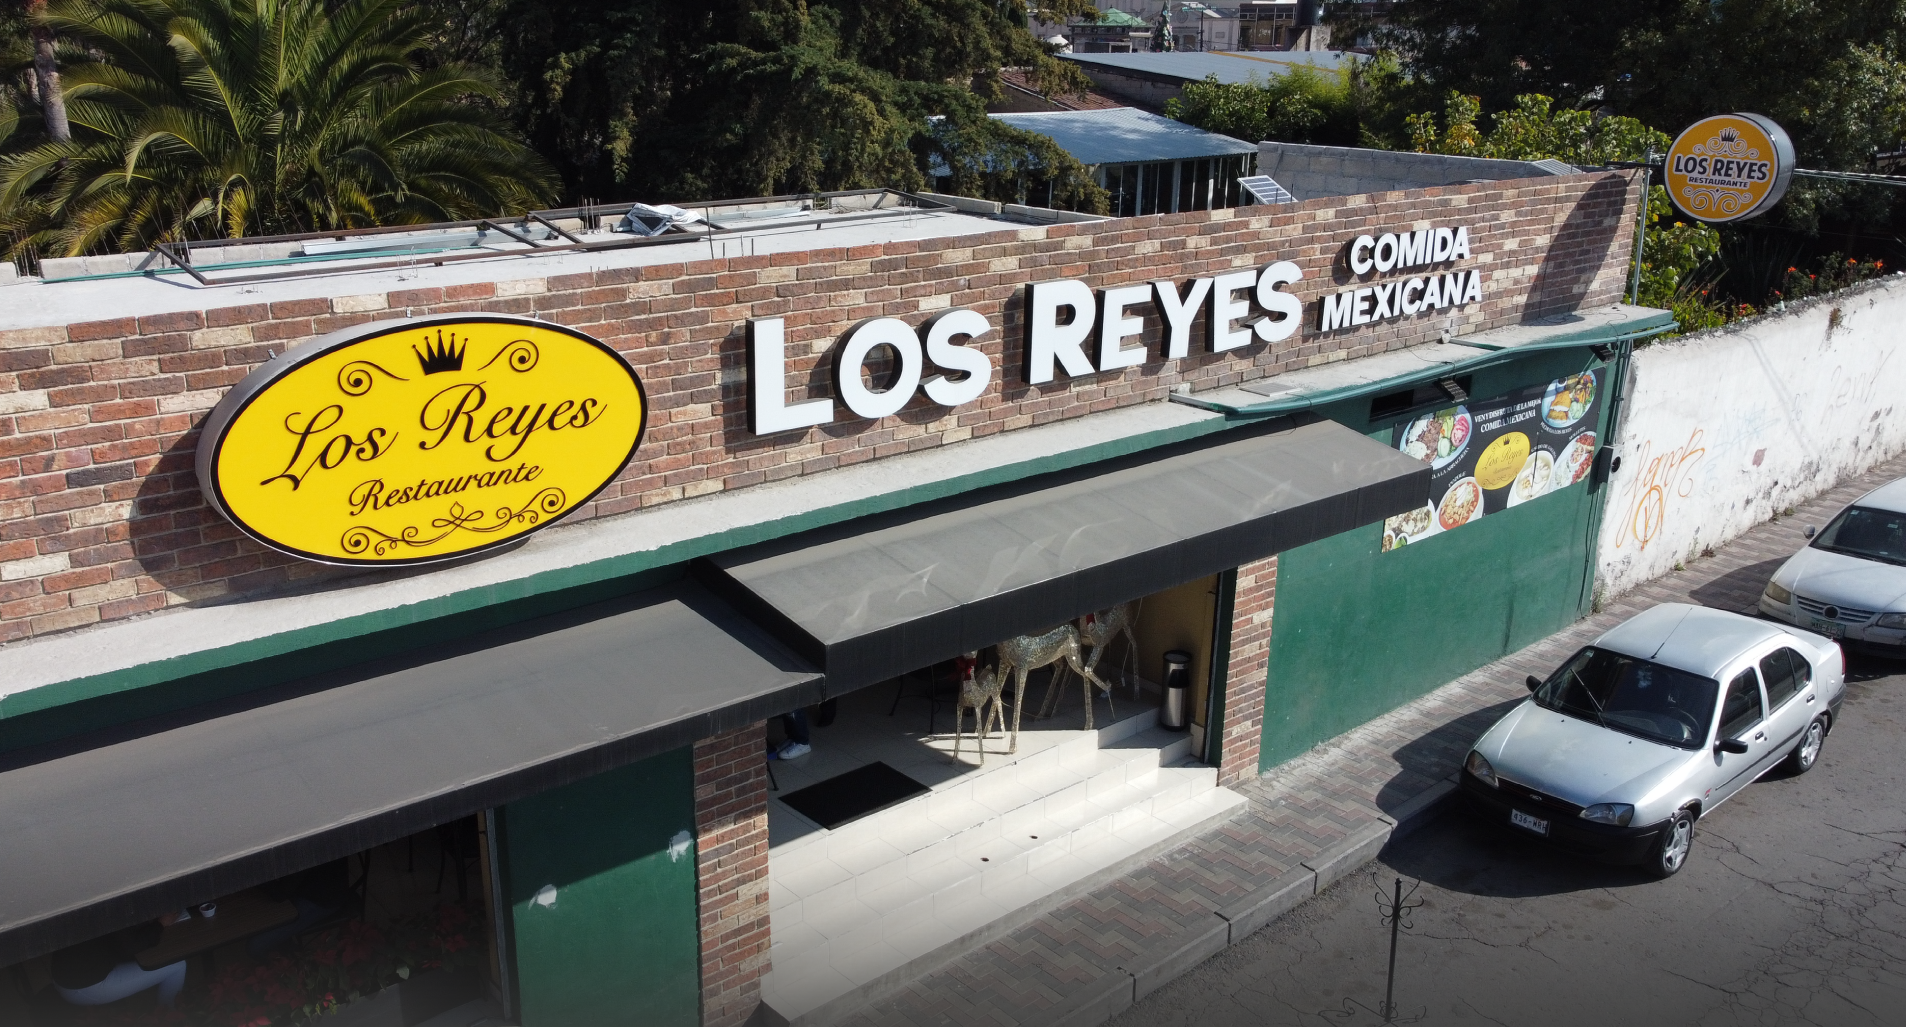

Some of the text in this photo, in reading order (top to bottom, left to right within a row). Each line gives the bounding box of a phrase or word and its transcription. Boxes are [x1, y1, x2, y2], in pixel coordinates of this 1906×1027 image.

[1674, 155, 1769, 181] LOS REYES
[1688, 176, 1749, 188] RESTAURANTE
[1348, 226, 1471, 275] COMIDA
[1321, 269, 1483, 332] MEXICANA
[748, 260, 1303, 435] LOS REYES
[259, 380, 608, 491] Los Reyes
[1480, 409, 1536, 433] COMIDA MEXICANA
[348, 462, 545, 516] Restaurante
